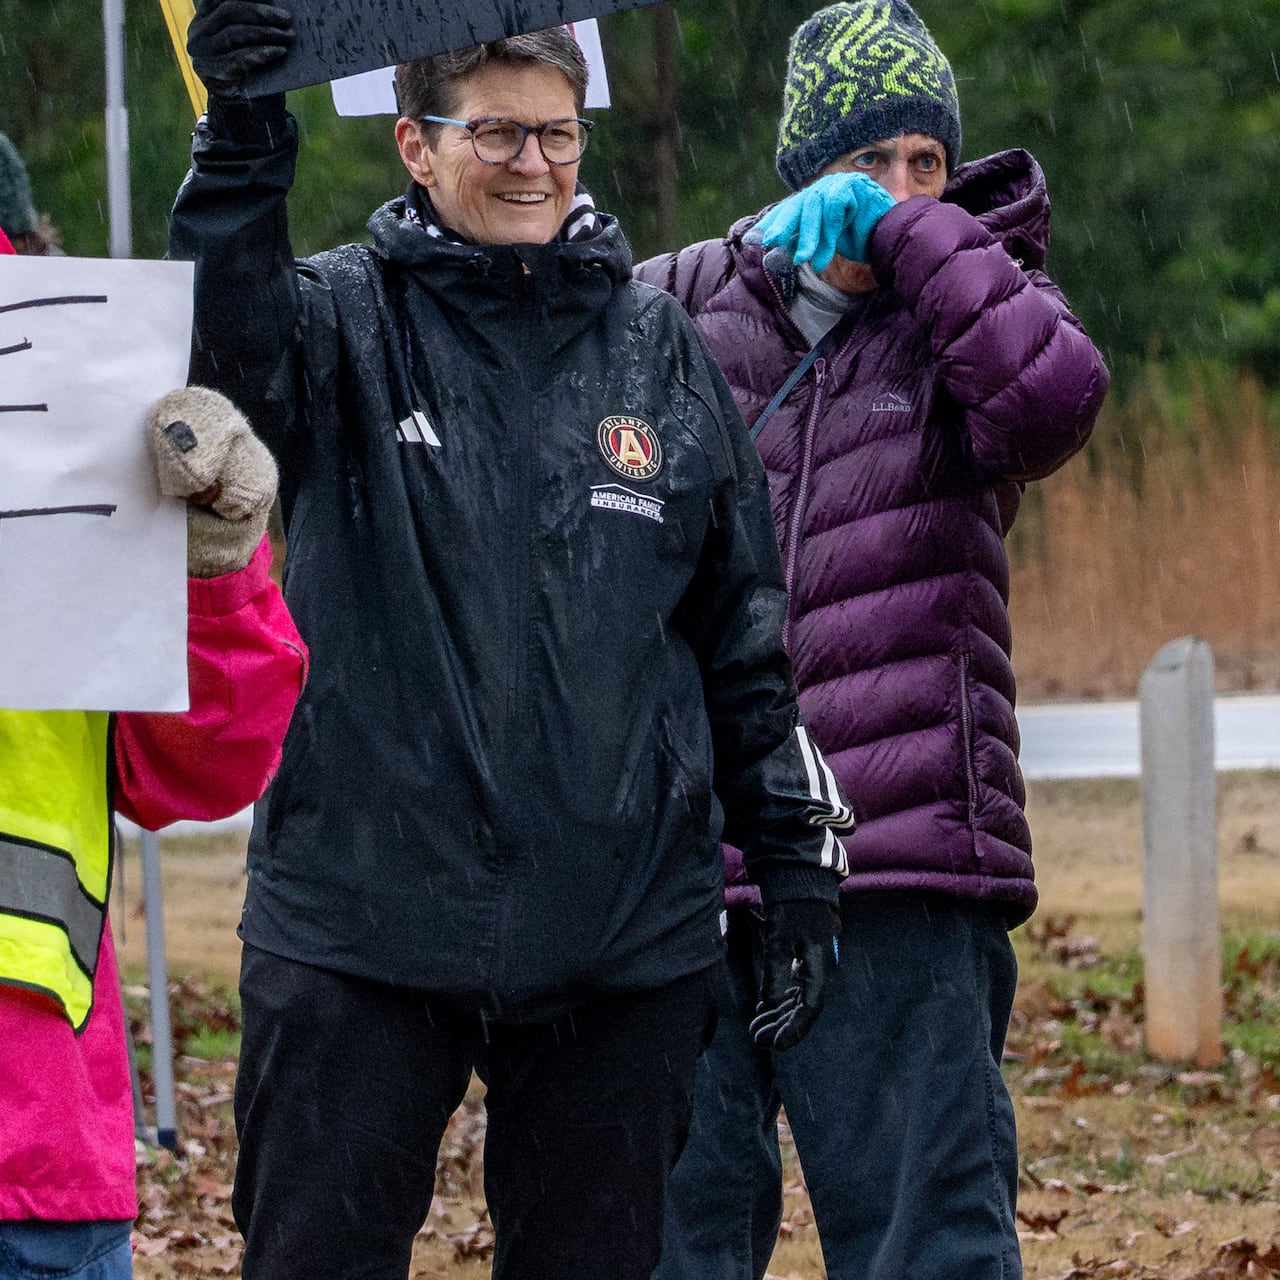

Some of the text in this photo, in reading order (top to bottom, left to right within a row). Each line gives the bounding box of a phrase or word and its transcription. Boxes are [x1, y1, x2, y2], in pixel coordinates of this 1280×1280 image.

[604, 418, 649, 434] ATLANTA
[610, 455, 658, 476] UNITED FC
[592, 491, 662, 512] AMERICAN FAMILY
[597, 500, 659, 518] INSURANCE
